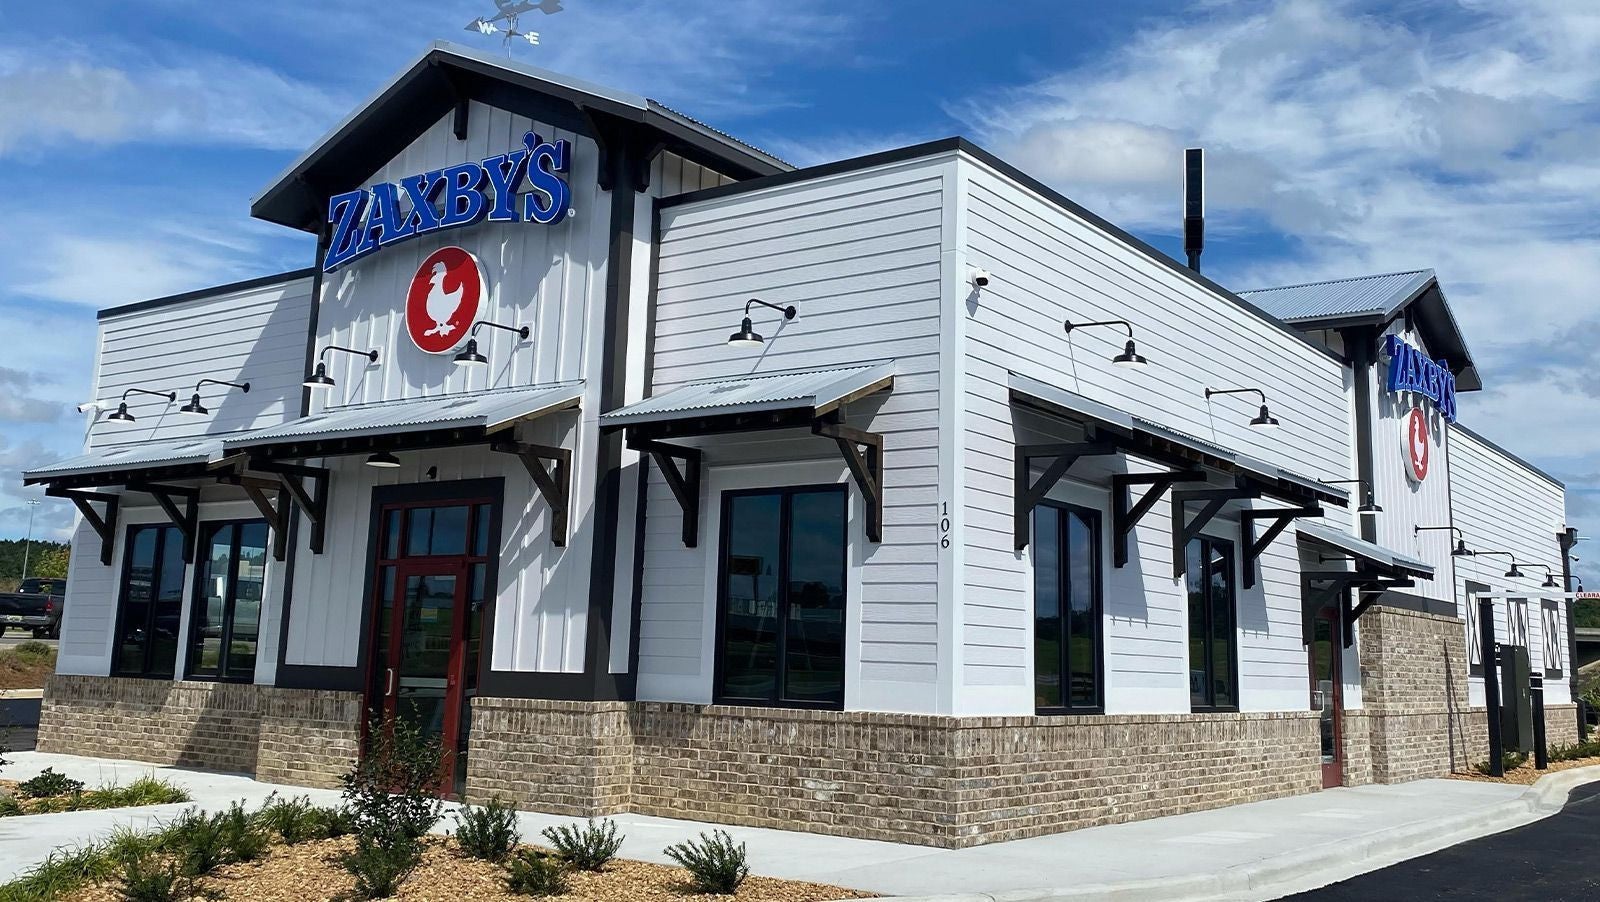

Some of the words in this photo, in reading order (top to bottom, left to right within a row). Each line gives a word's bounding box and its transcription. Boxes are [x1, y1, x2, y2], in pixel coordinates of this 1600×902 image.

[529, 31, 540, 45] E
[323, 131, 571, 272] ZAXBY'S
[1386, 334, 1456, 424] ZAXBY'S
[941, 501, 950, 548] 106
